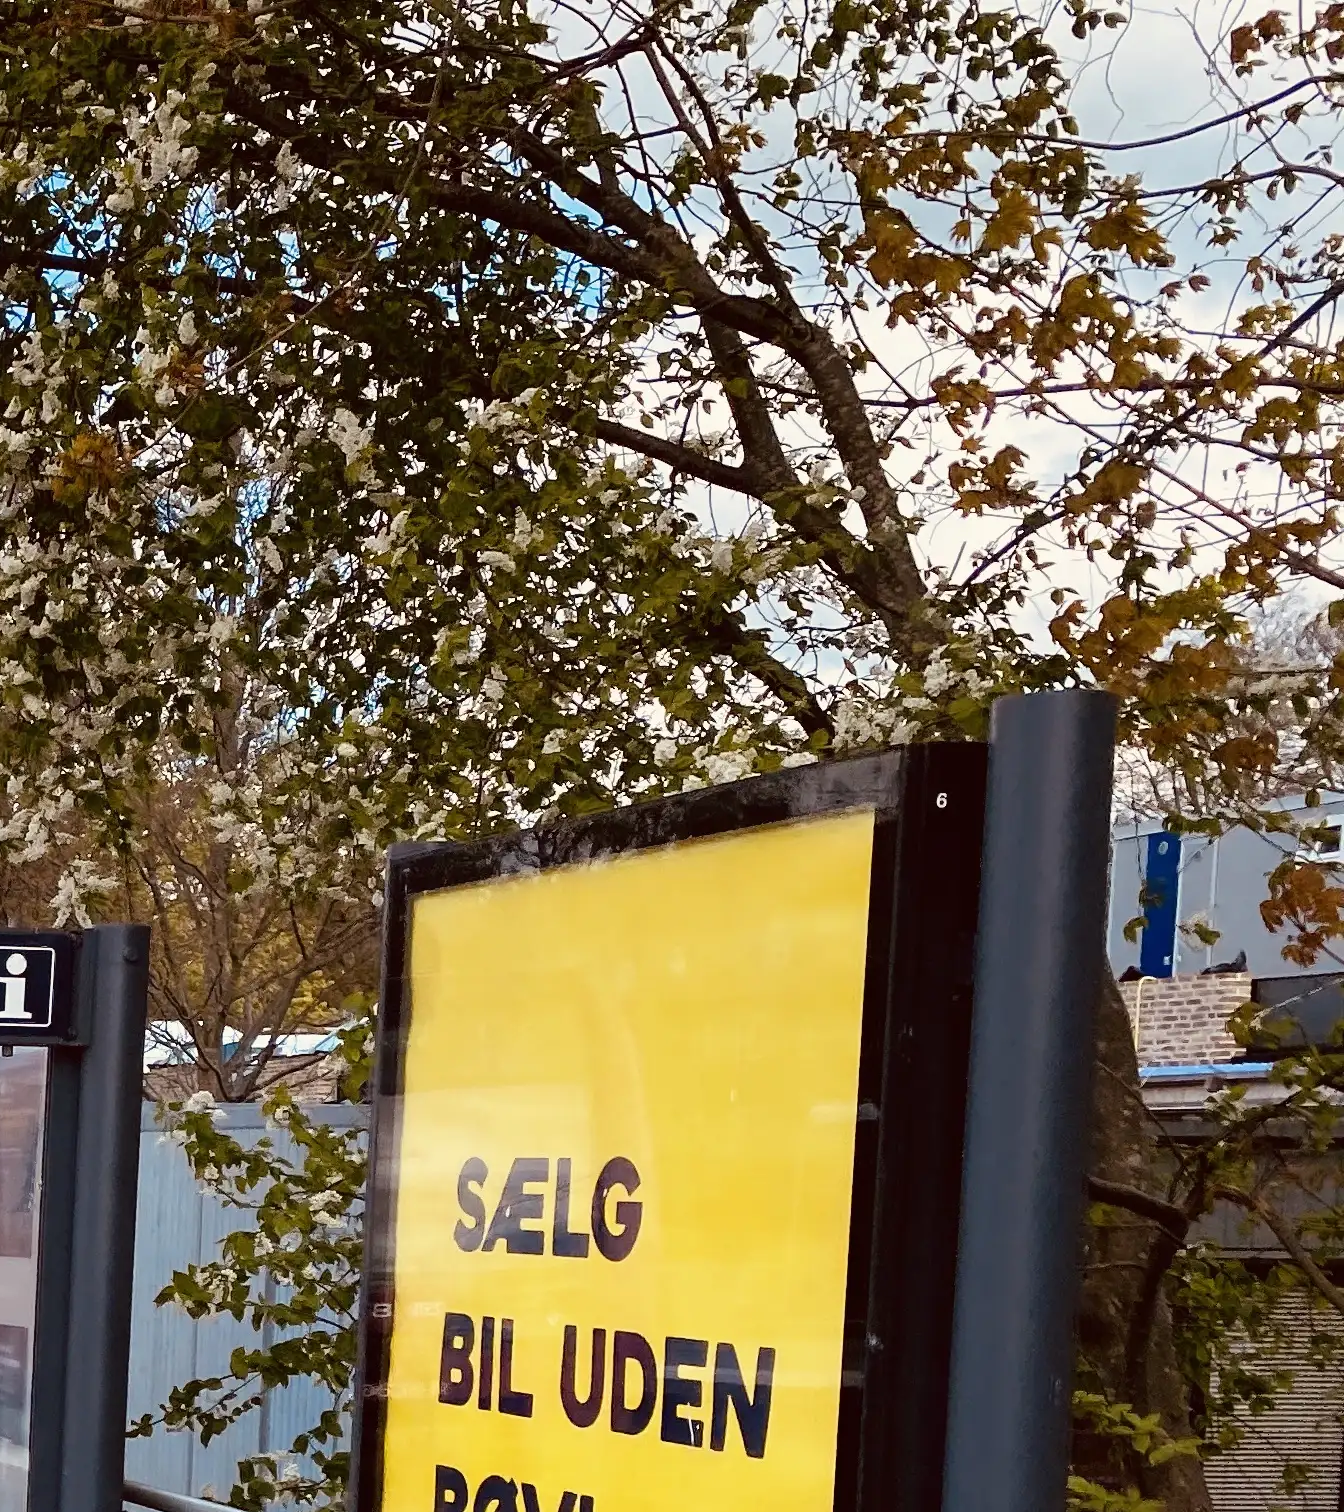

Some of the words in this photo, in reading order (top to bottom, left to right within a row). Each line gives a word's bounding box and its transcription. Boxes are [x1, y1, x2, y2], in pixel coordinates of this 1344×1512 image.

[936, 792, 948, 809] 6
[453, 1156, 644, 1262] SÆLG
[438, 1312, 534, 1418] BIL
[560, 1324, 776, 1459] UDEN
